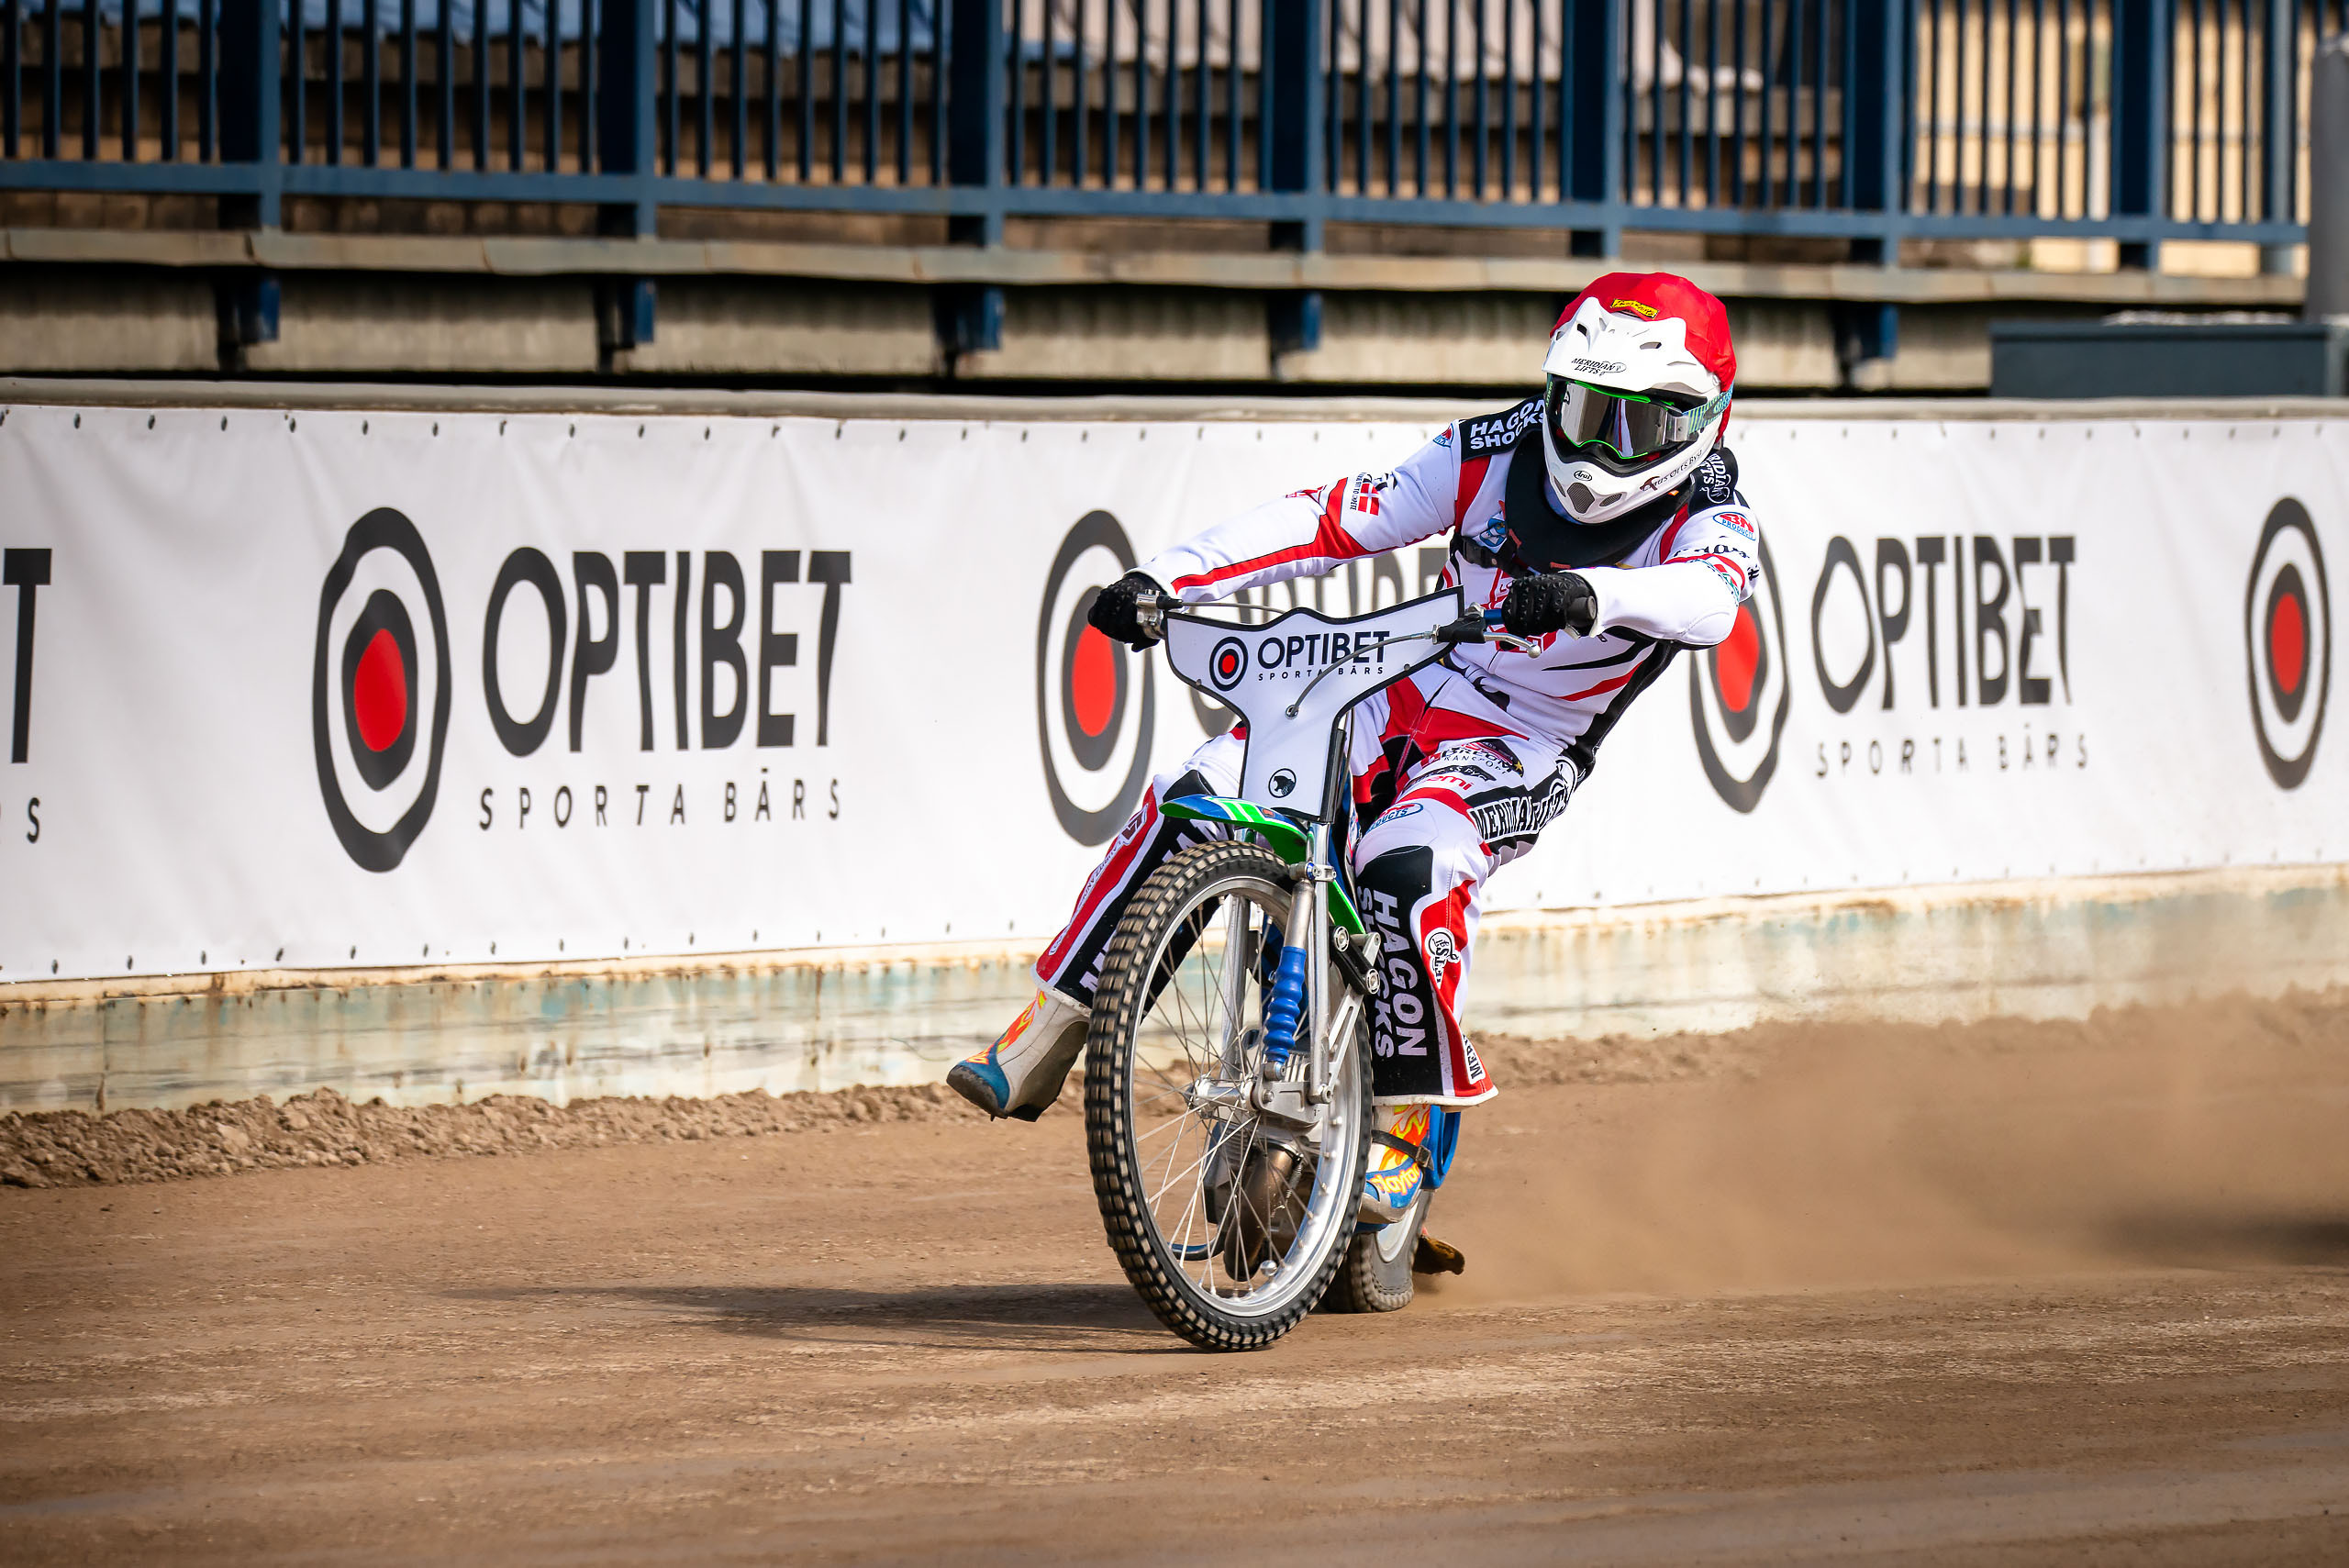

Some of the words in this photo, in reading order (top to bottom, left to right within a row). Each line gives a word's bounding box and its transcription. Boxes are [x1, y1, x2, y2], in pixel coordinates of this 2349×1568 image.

[1571, 359, 1616, 372] MERIDIAN
[1574, 365, 1601, 375] LIFTS
[1257, 630, 1390, 669] OPTIBET
[1811, 534, 2076, 714] OPTIBET
[482, 546, 852, 758] OPTIBET
[1258, 668, 1322, 682] SPORTA
[1338, 665, 1384, 676] BĀRS
[1817, 736, 1969, 779] SPORTA
[479, 784, 687, 831] SPORTA
[724, 768, 841, 824] BĀRS
[1357, 885, 1396, 1058] SHCKS
[1374, 889, 1428, 1056] HAGON
